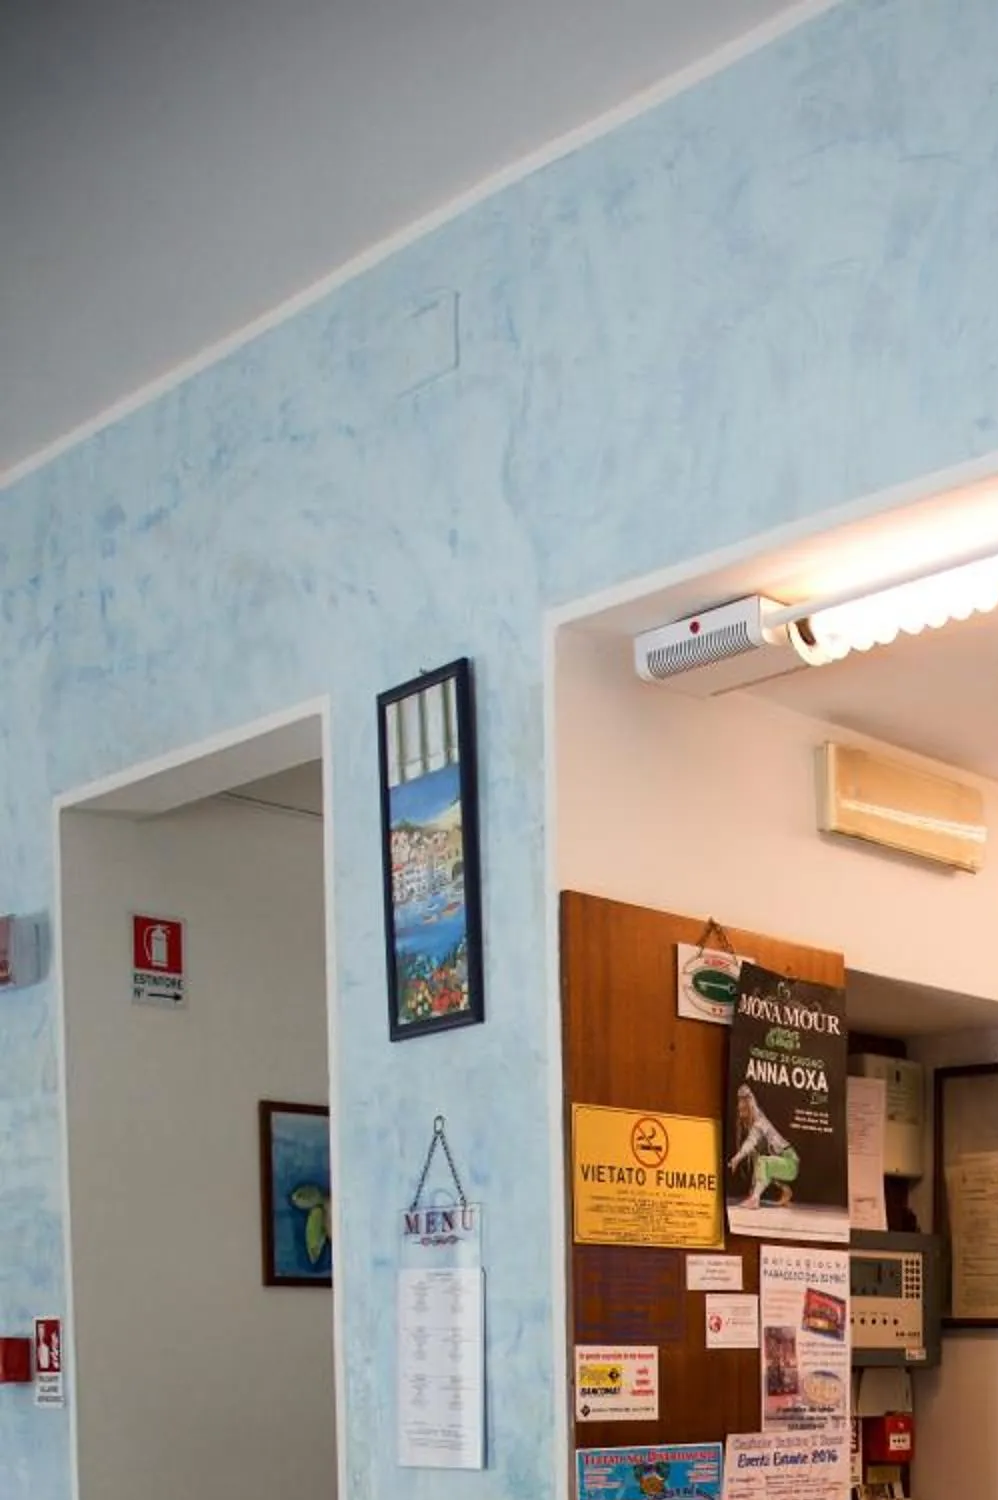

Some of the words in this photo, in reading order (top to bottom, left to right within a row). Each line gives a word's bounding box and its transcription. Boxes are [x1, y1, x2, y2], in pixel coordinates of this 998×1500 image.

[745, 1058, 791, 1088] ANNA
[791, 1067, 829, 1093] OXA
[580, 1163, 647, 1187] VIETATO
[655, 1169, 717, 1192] FUMARE
[403, 1209, 475, 1235] MENU
